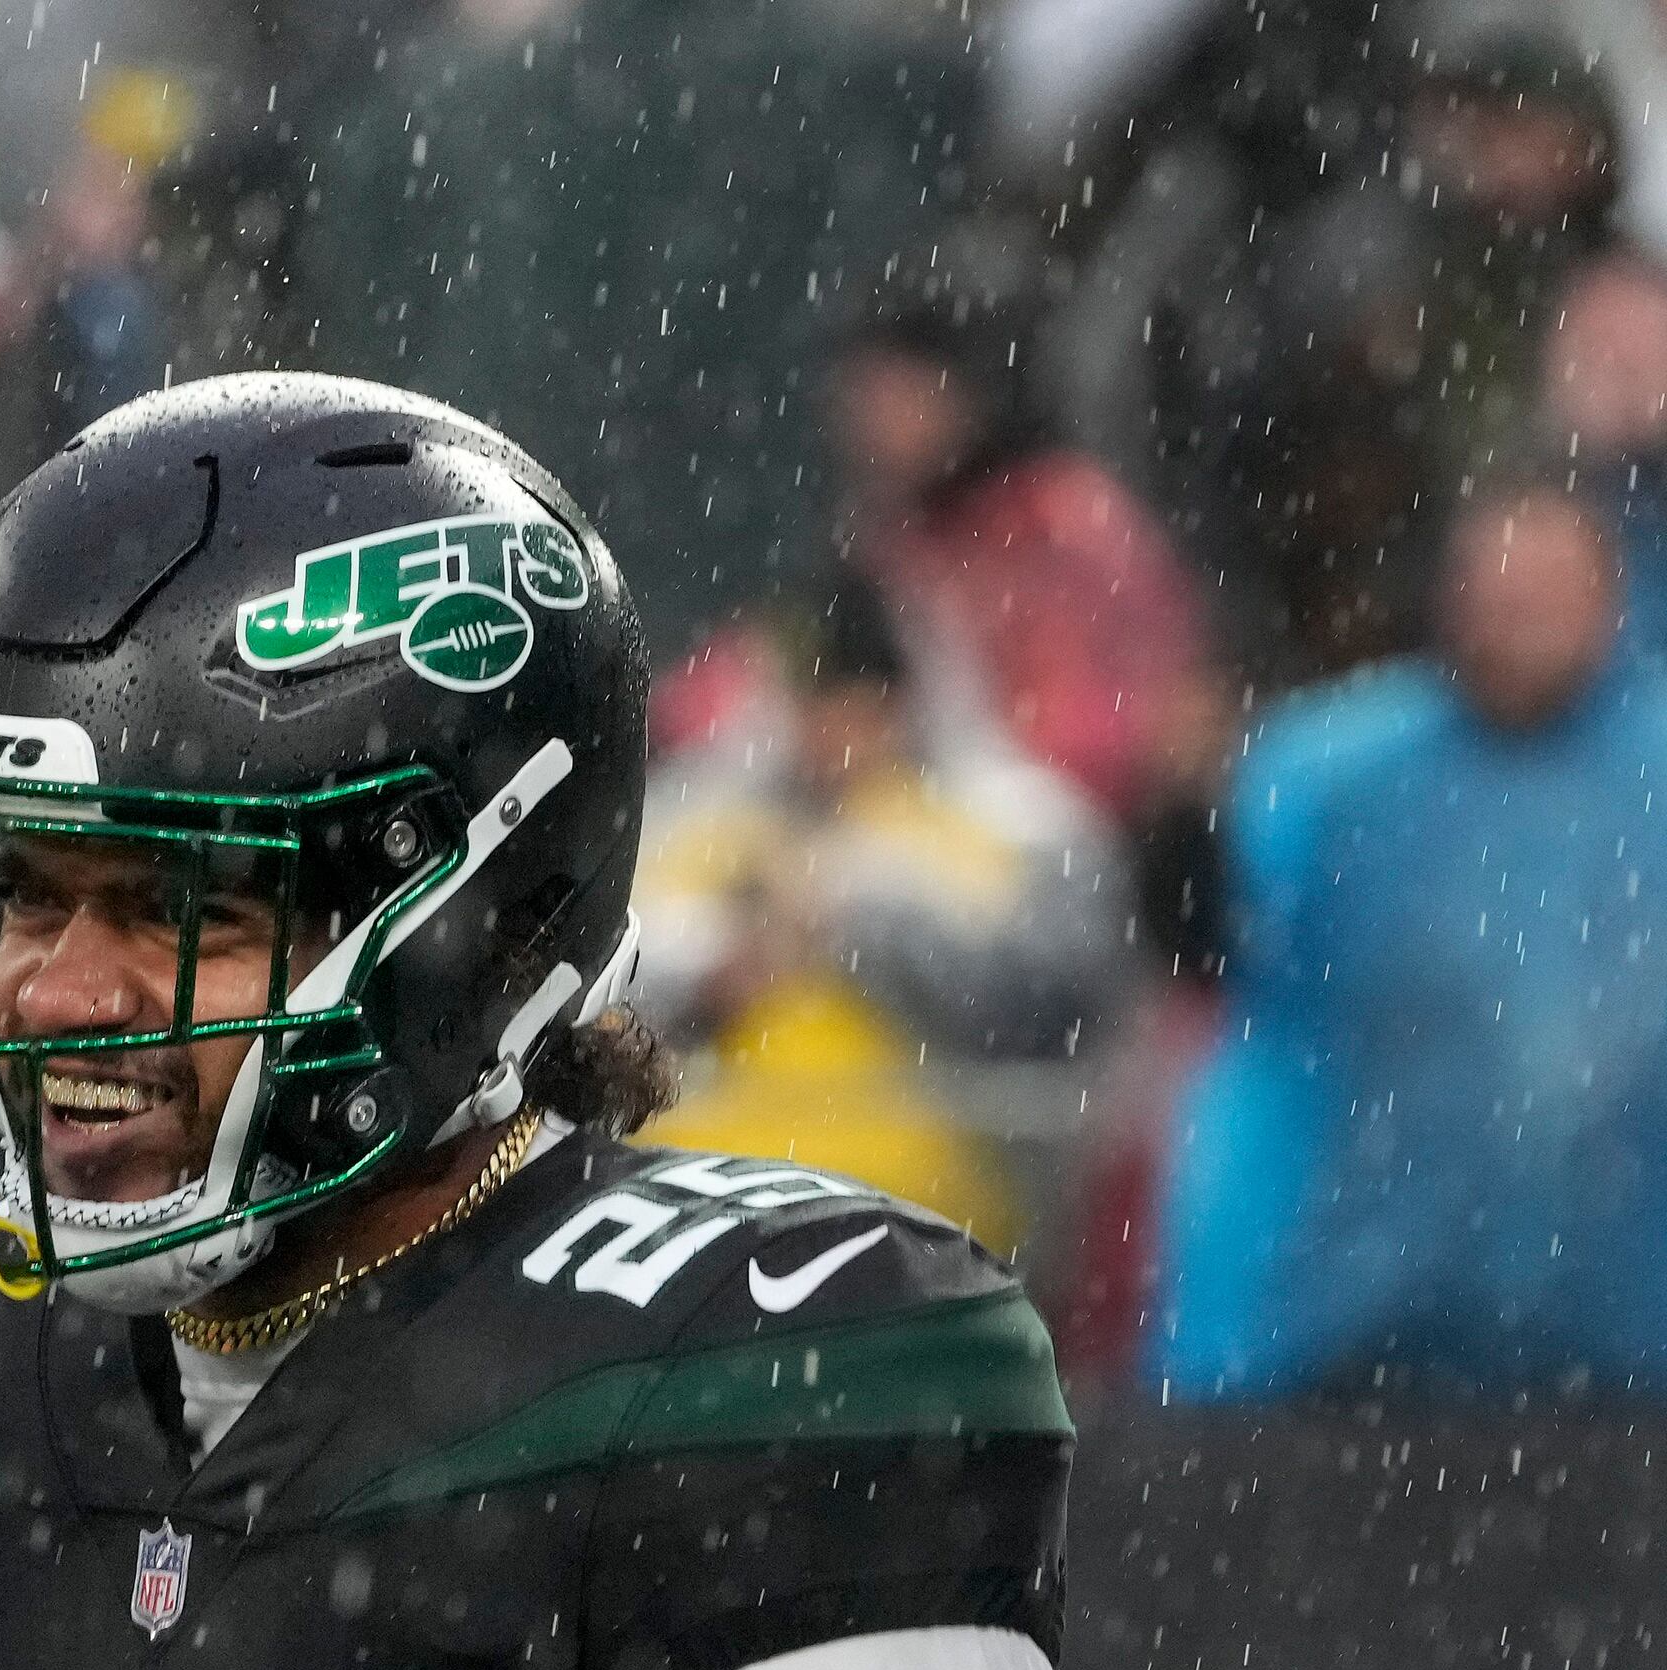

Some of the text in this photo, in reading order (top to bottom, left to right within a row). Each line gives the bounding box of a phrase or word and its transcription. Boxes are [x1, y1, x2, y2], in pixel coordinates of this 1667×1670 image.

[236, 512, 589, 672] JETS
[521, 1154, 862, 1309] 25
[139, 1573, 175, 1617] NFL
